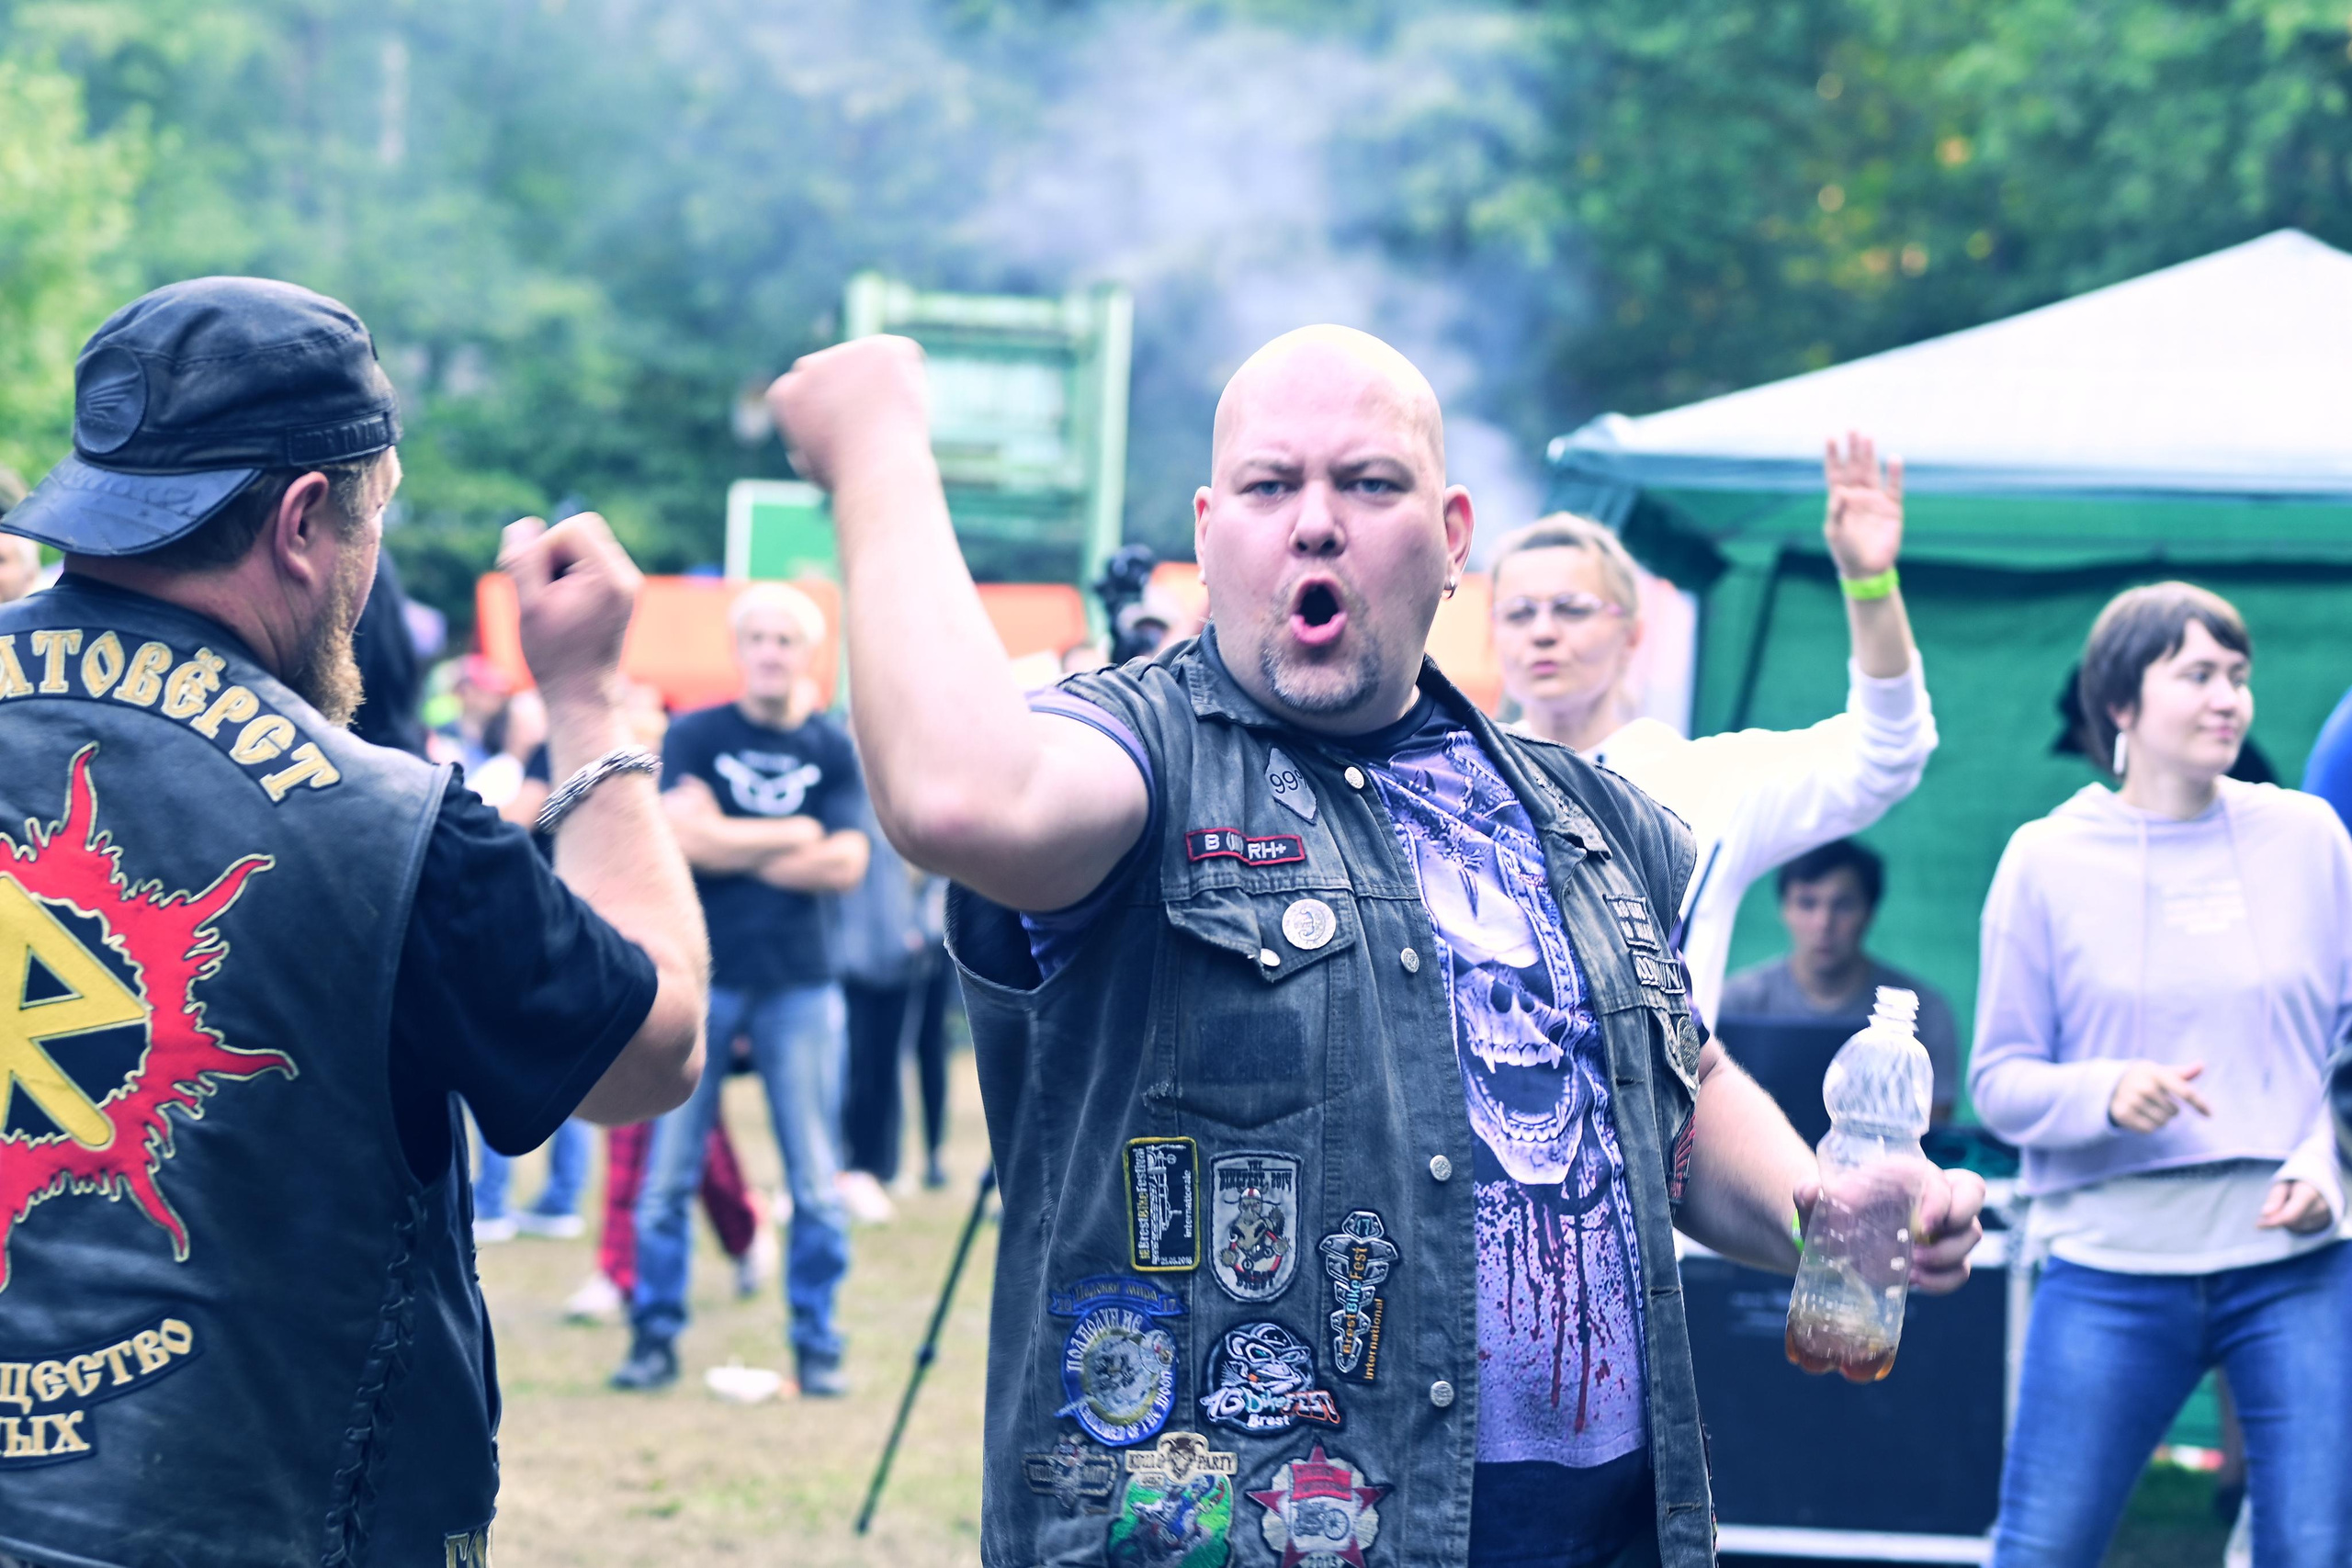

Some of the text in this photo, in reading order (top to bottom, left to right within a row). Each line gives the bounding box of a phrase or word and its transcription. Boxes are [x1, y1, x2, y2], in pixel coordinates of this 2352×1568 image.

[1204, 834, 1220, 851] B
[1248, 842, 1287, 860] RH+
[1247, 1414, 1290, 1428] Brest
